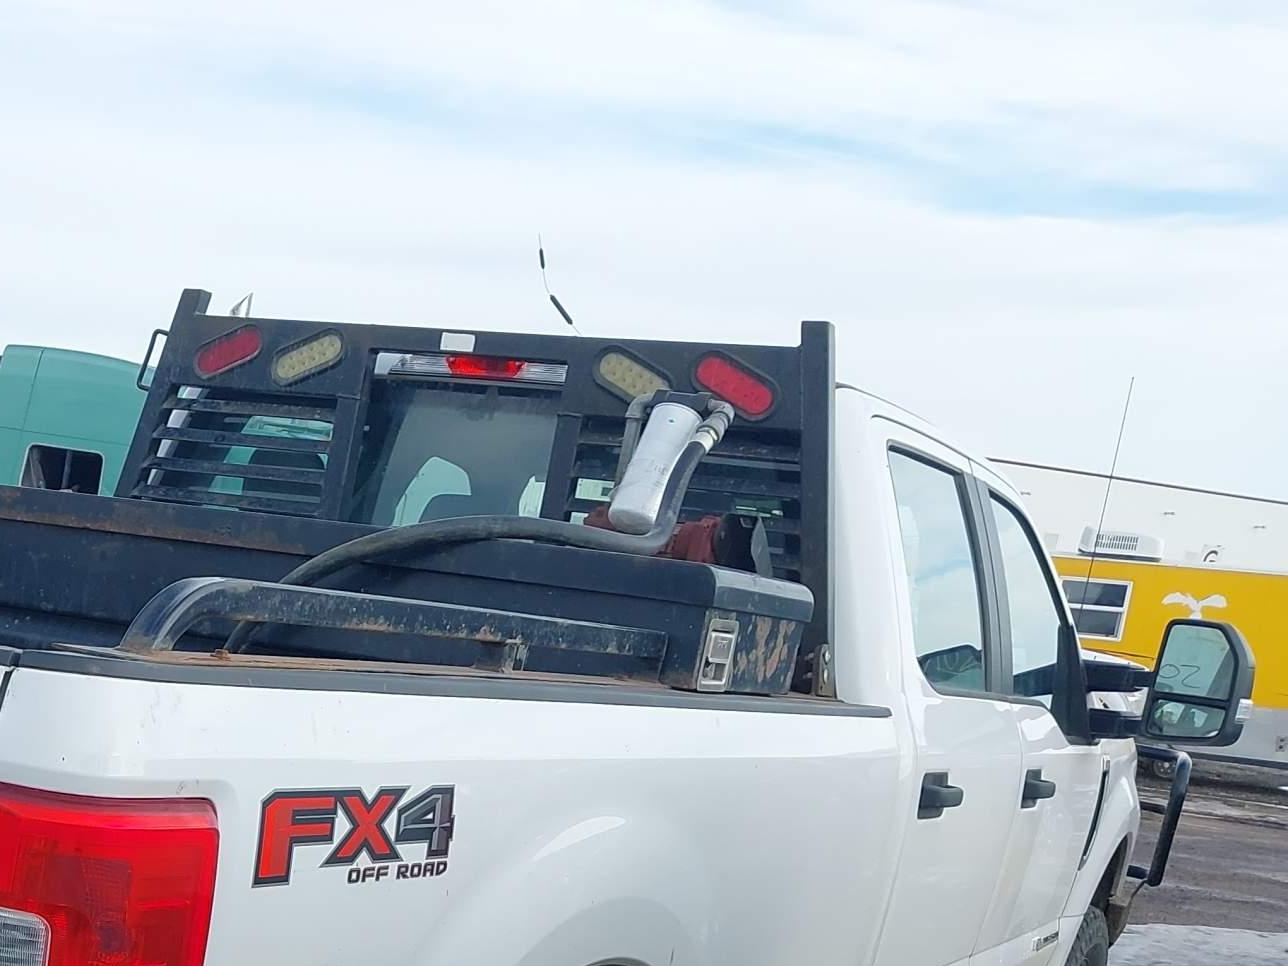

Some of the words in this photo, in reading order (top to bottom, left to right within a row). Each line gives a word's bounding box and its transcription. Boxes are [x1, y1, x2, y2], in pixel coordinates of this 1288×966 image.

[251, 784, 456, 888] FX4
[347, 864, 389, 884] OFF
[395, 860, 448, 880] ROAD
